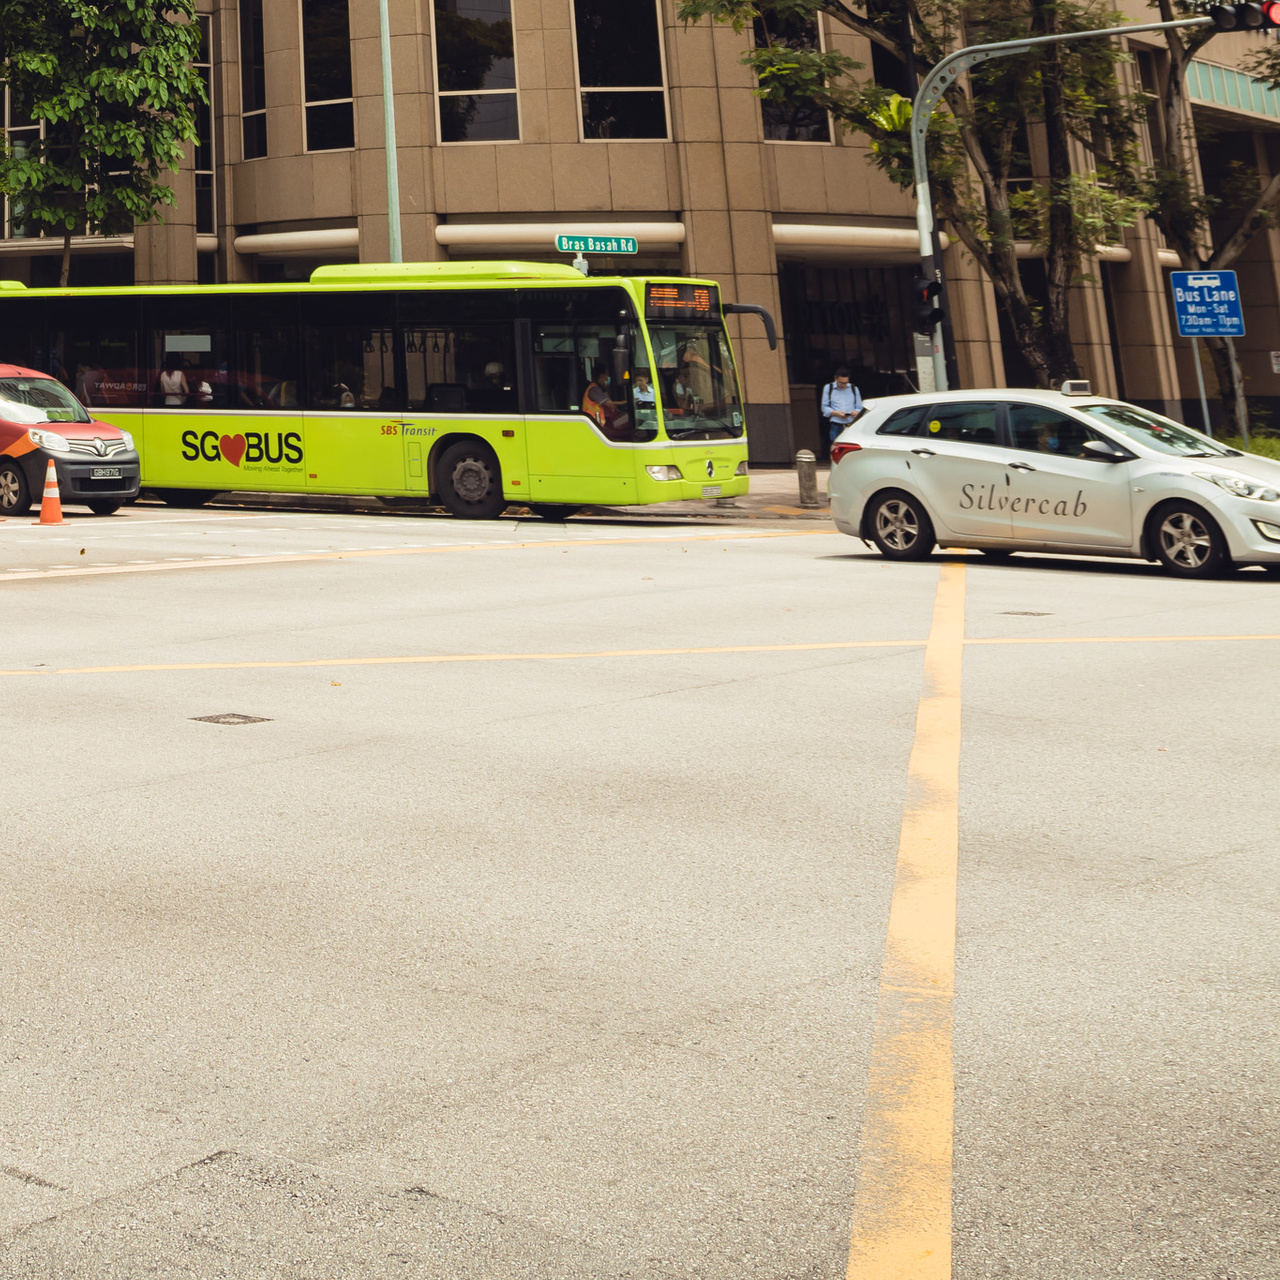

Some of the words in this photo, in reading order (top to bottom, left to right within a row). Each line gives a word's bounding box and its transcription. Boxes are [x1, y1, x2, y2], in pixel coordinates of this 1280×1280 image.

[562, 237, 585, 250] Bras
[588, 238, 618, 251] Basah
[621, 239, 634, 251] Rd
[1175, 287, 1201, 302] Bus
[1203, 287, 1236, 302] Lane
[381, 425, 398, 436] SBS
[397, 423, 438, 436] Transit
[959, 483, 1087, 517] Silvercab
